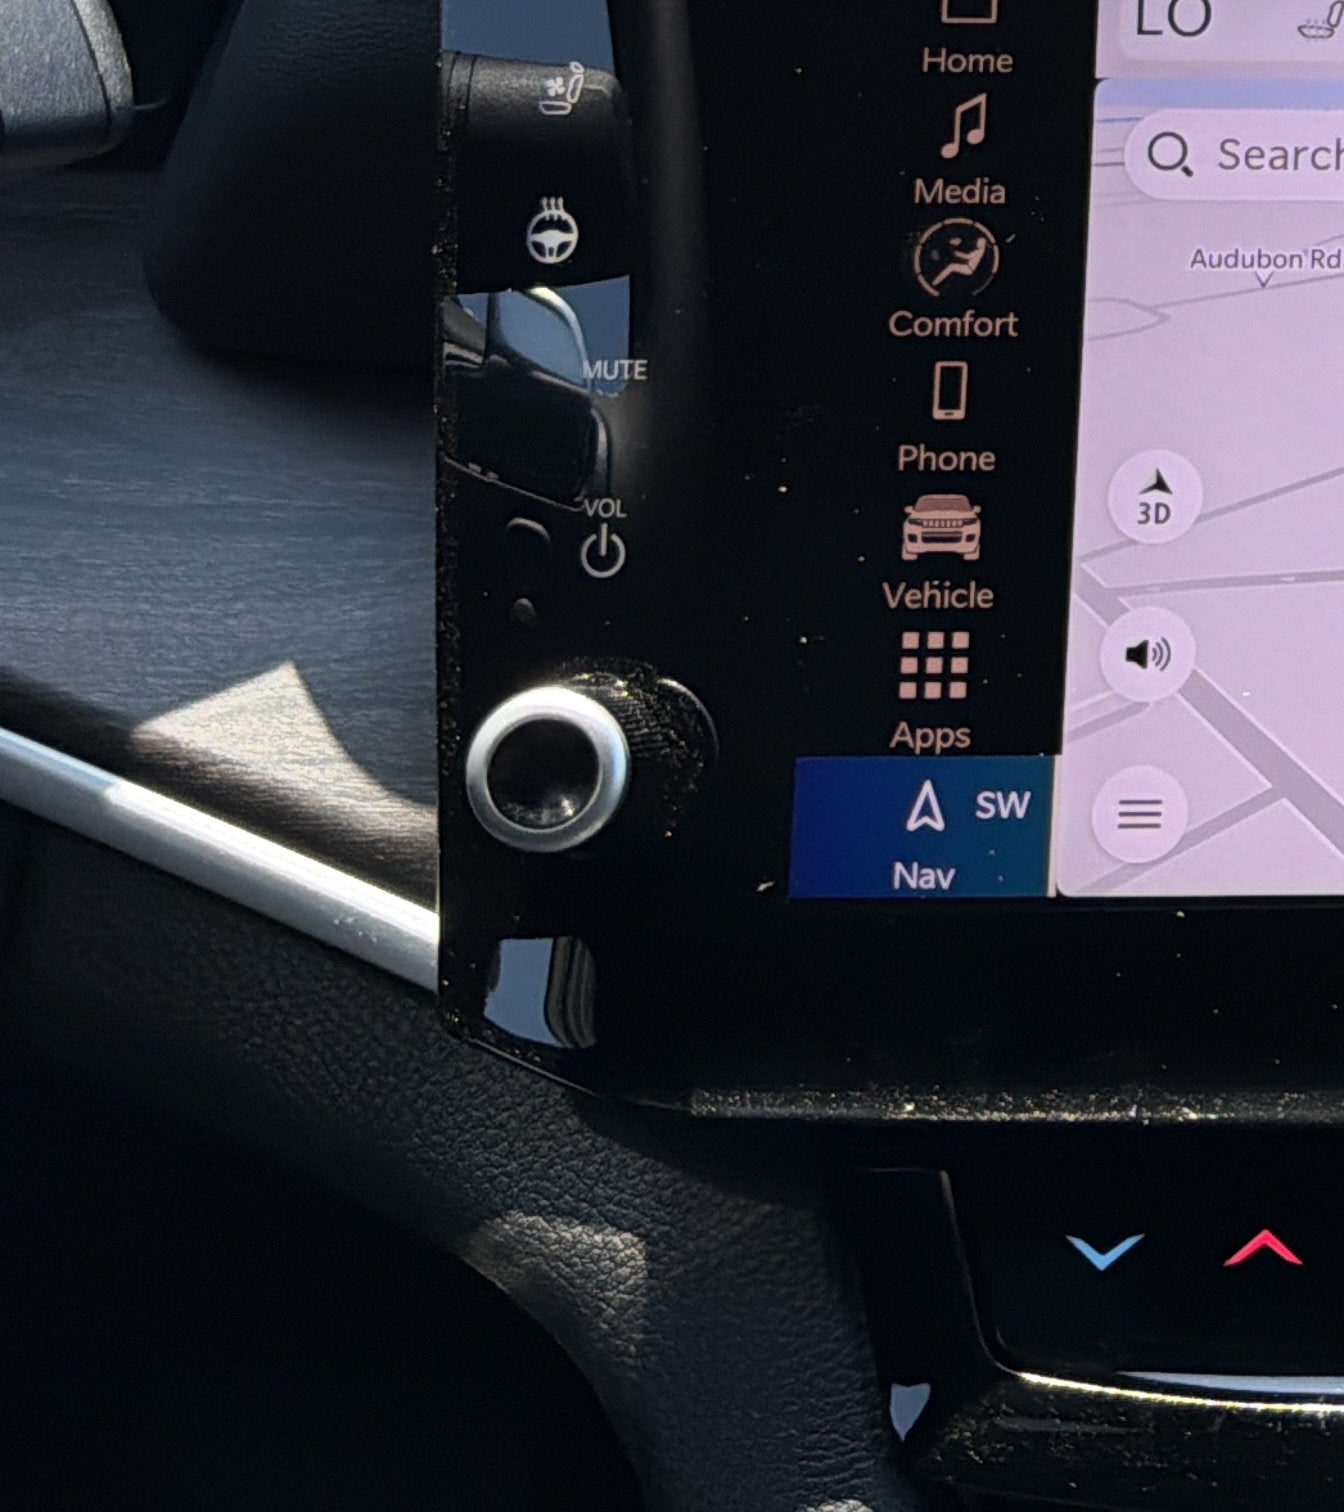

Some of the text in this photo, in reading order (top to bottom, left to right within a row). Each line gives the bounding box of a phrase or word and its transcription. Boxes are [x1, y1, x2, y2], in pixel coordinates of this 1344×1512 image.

[921, 46, 1015, 74] Home
[913, 176, 1007, 206] Media
[1190, 248, 1342, 270] Audubon Rd
[887, 309, 1020, 338] Comfort
[583, 359, 648, 380] MUTE
[897, 442, 997, 472] Phone
[584, 497, 627, 520] VOL
[1136, 501, 1172, 526] 3D
[881, 580, 995, 610] Vehicle
[889, 721, 972, 755] Apps
[974, 790, 1031, 820] SW
[892, 860, 957, 890] Nav
